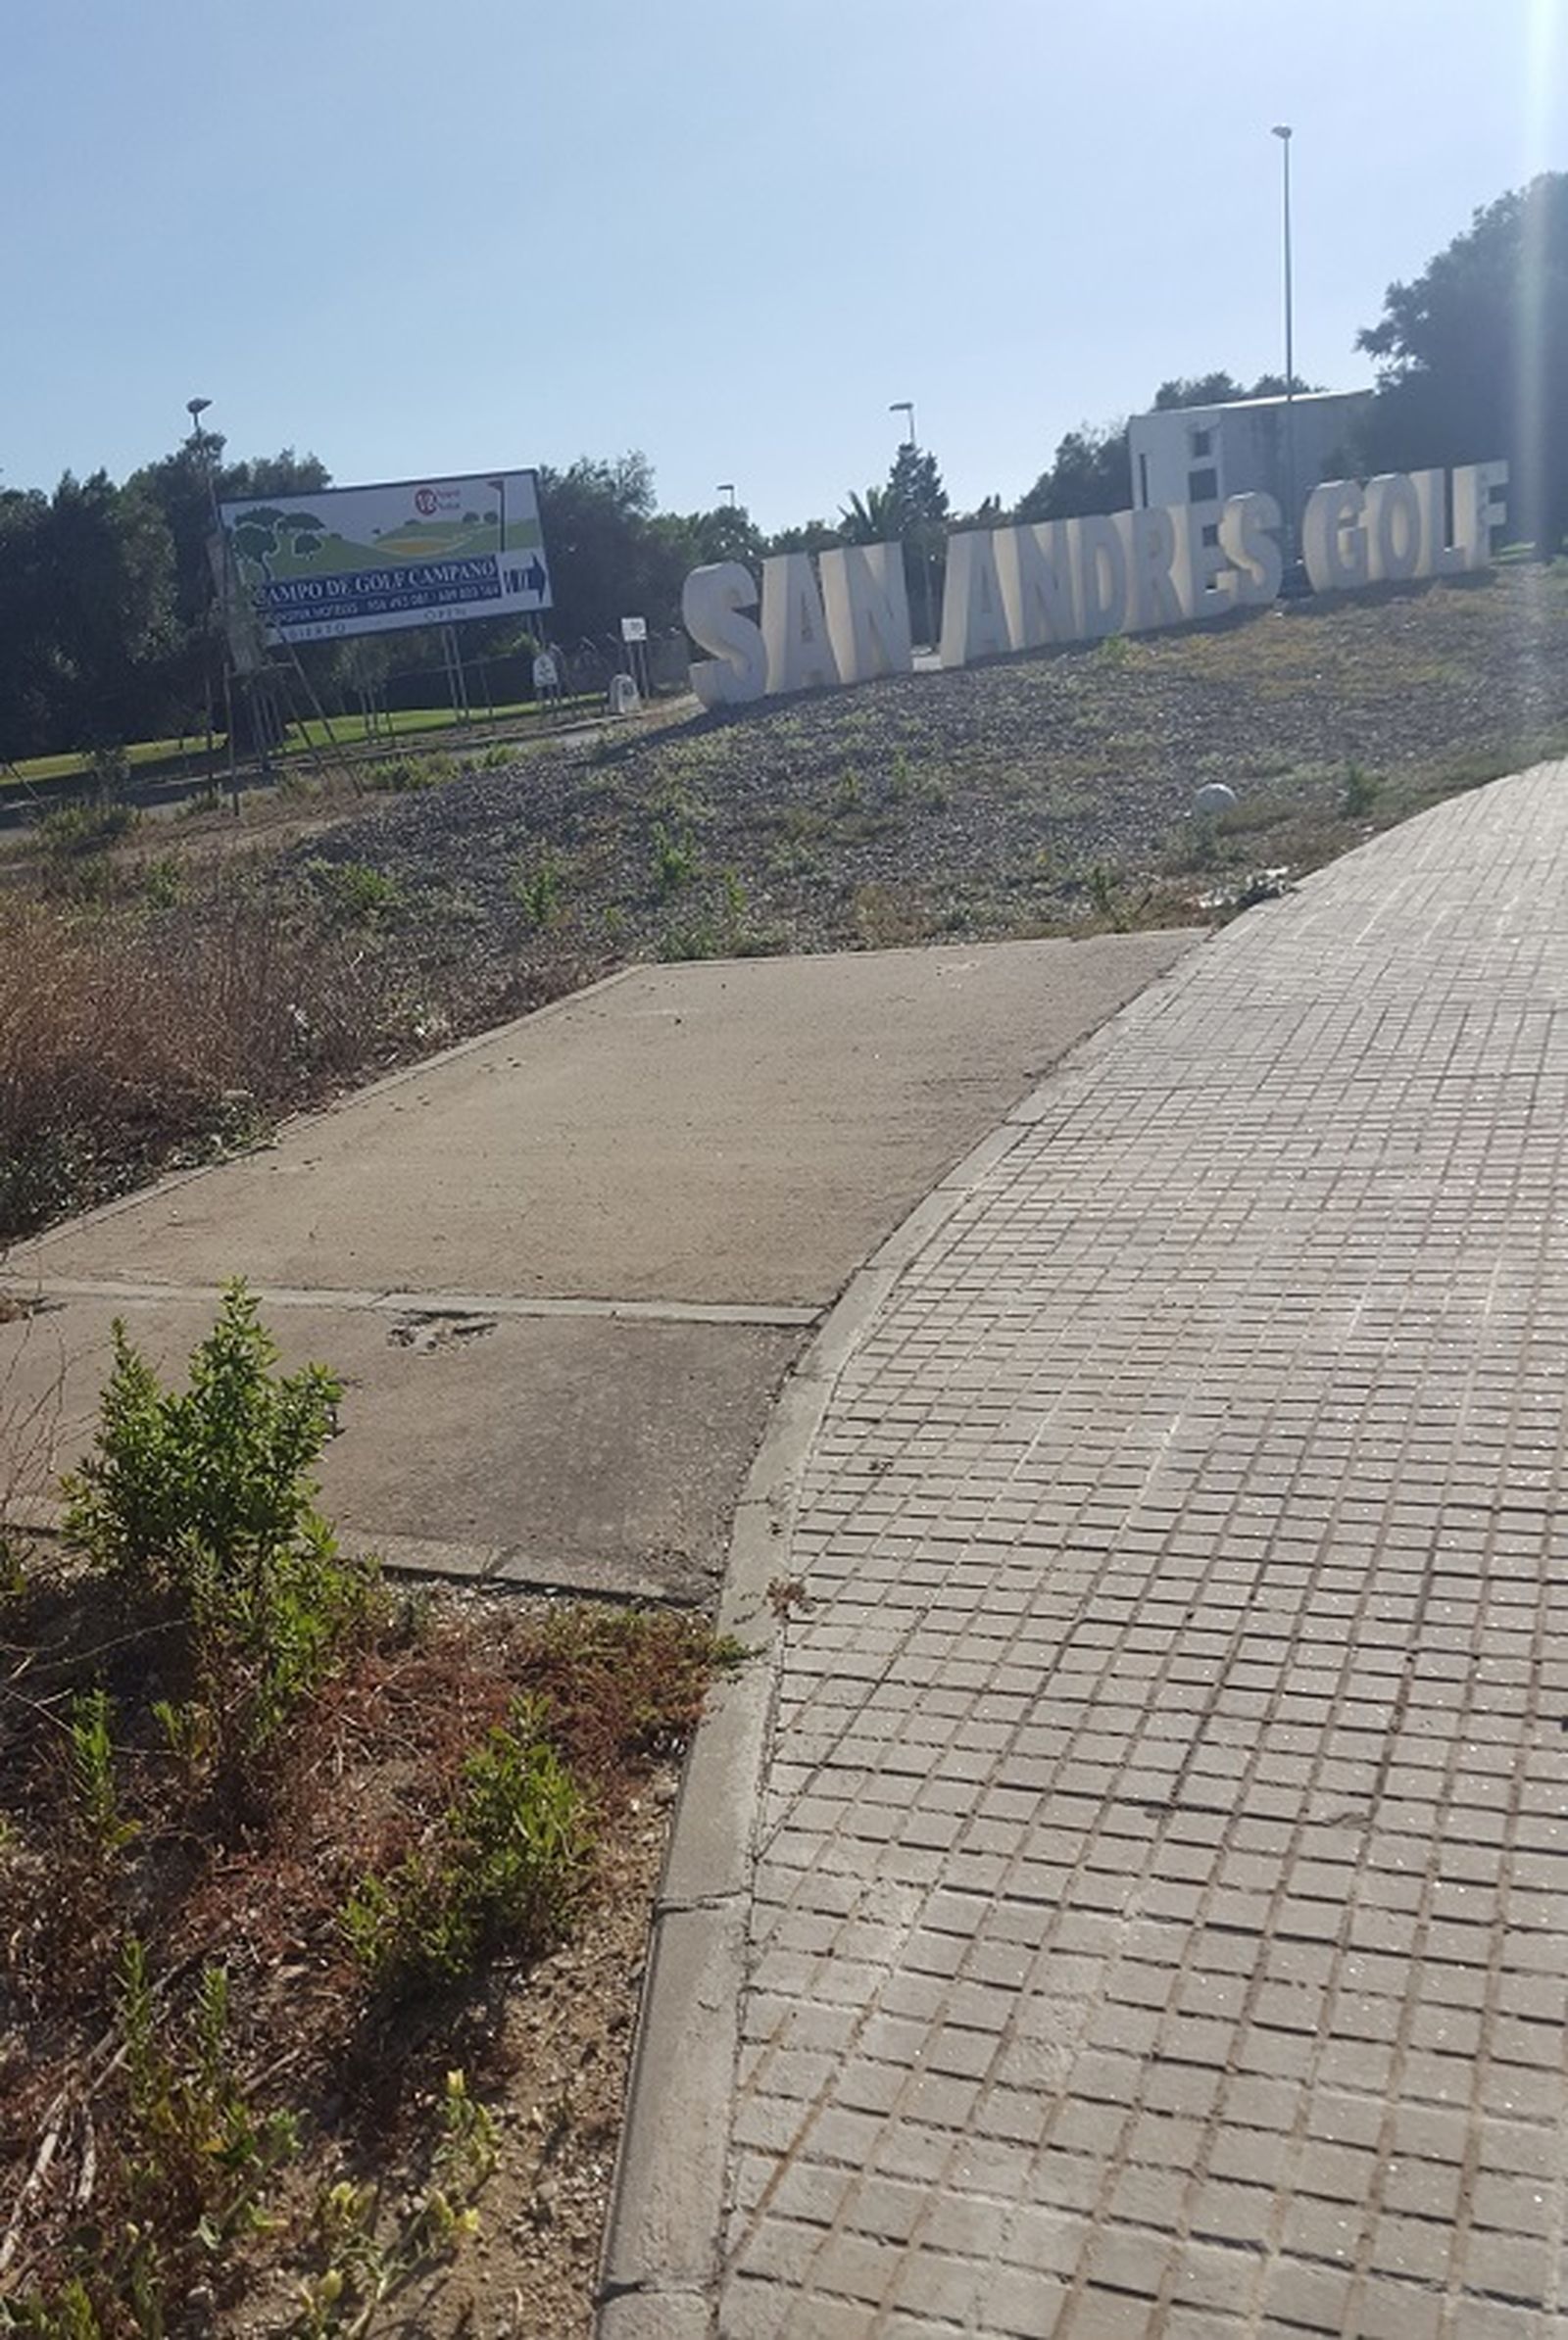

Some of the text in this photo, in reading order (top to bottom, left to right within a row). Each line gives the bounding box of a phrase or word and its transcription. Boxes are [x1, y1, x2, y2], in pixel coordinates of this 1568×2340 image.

[256, 560, 496, 606] CAMPO DE GOLF CAMPANO
[682, 460, 1510, 711] SAN ANDRES GOLF
